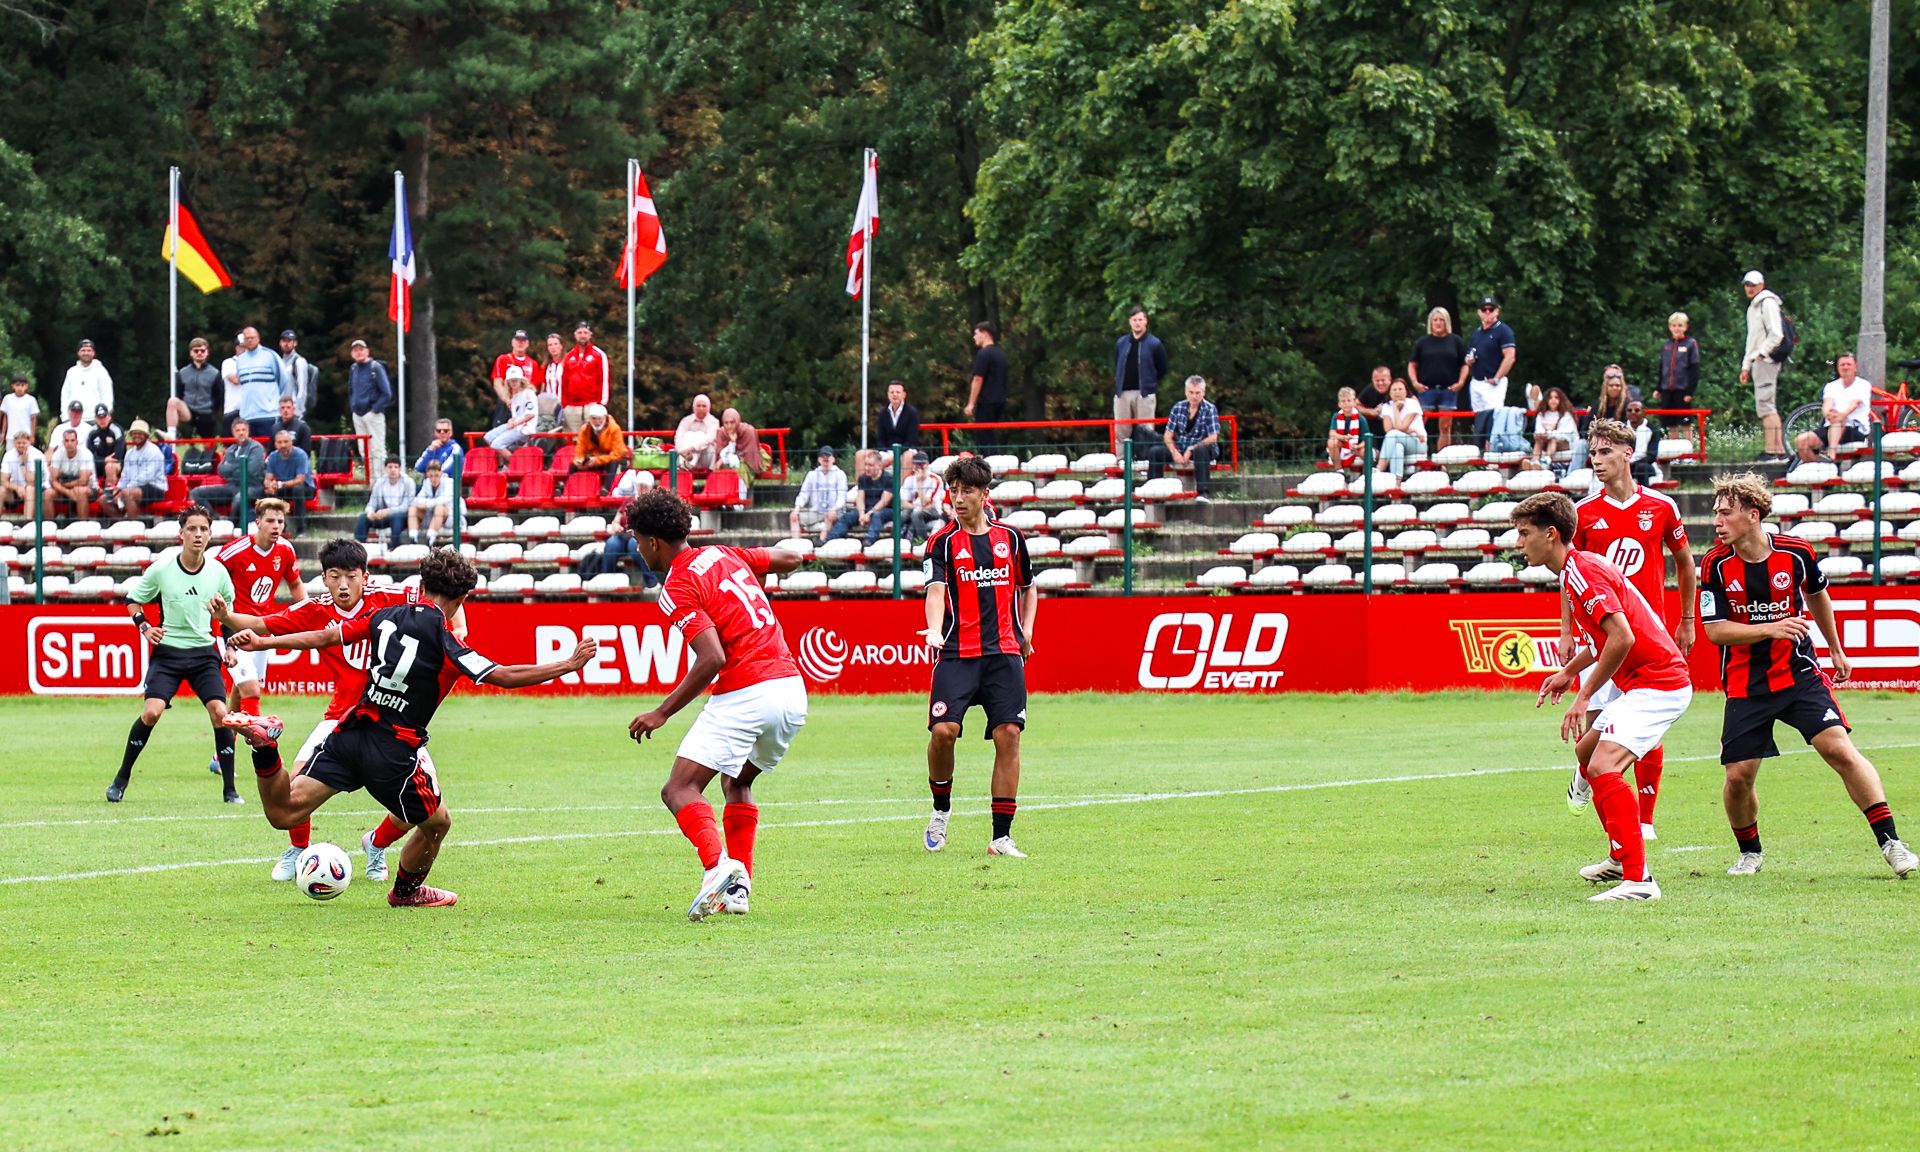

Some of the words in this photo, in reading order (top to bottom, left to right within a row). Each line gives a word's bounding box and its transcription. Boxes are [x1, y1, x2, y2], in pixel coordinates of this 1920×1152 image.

[1613, 538, 1640, 575] hp
[958, 564, 1009, 582] indeed
[977, 580, 991, 588] Jobs
[253, 576, 273, 604] hp
[719, 567, 776, 630] 15
[1729, 596, 1790, 613] indeed
[1768, 611, 1791, 620] finden
[41, 631, 134, 678] SFm
[371, 619, 419, 694] 11
[535, 625, 697, 685] REW
[850, 644, 935, 665] AROUN
[1138, 612, 1289, 689] OLD
